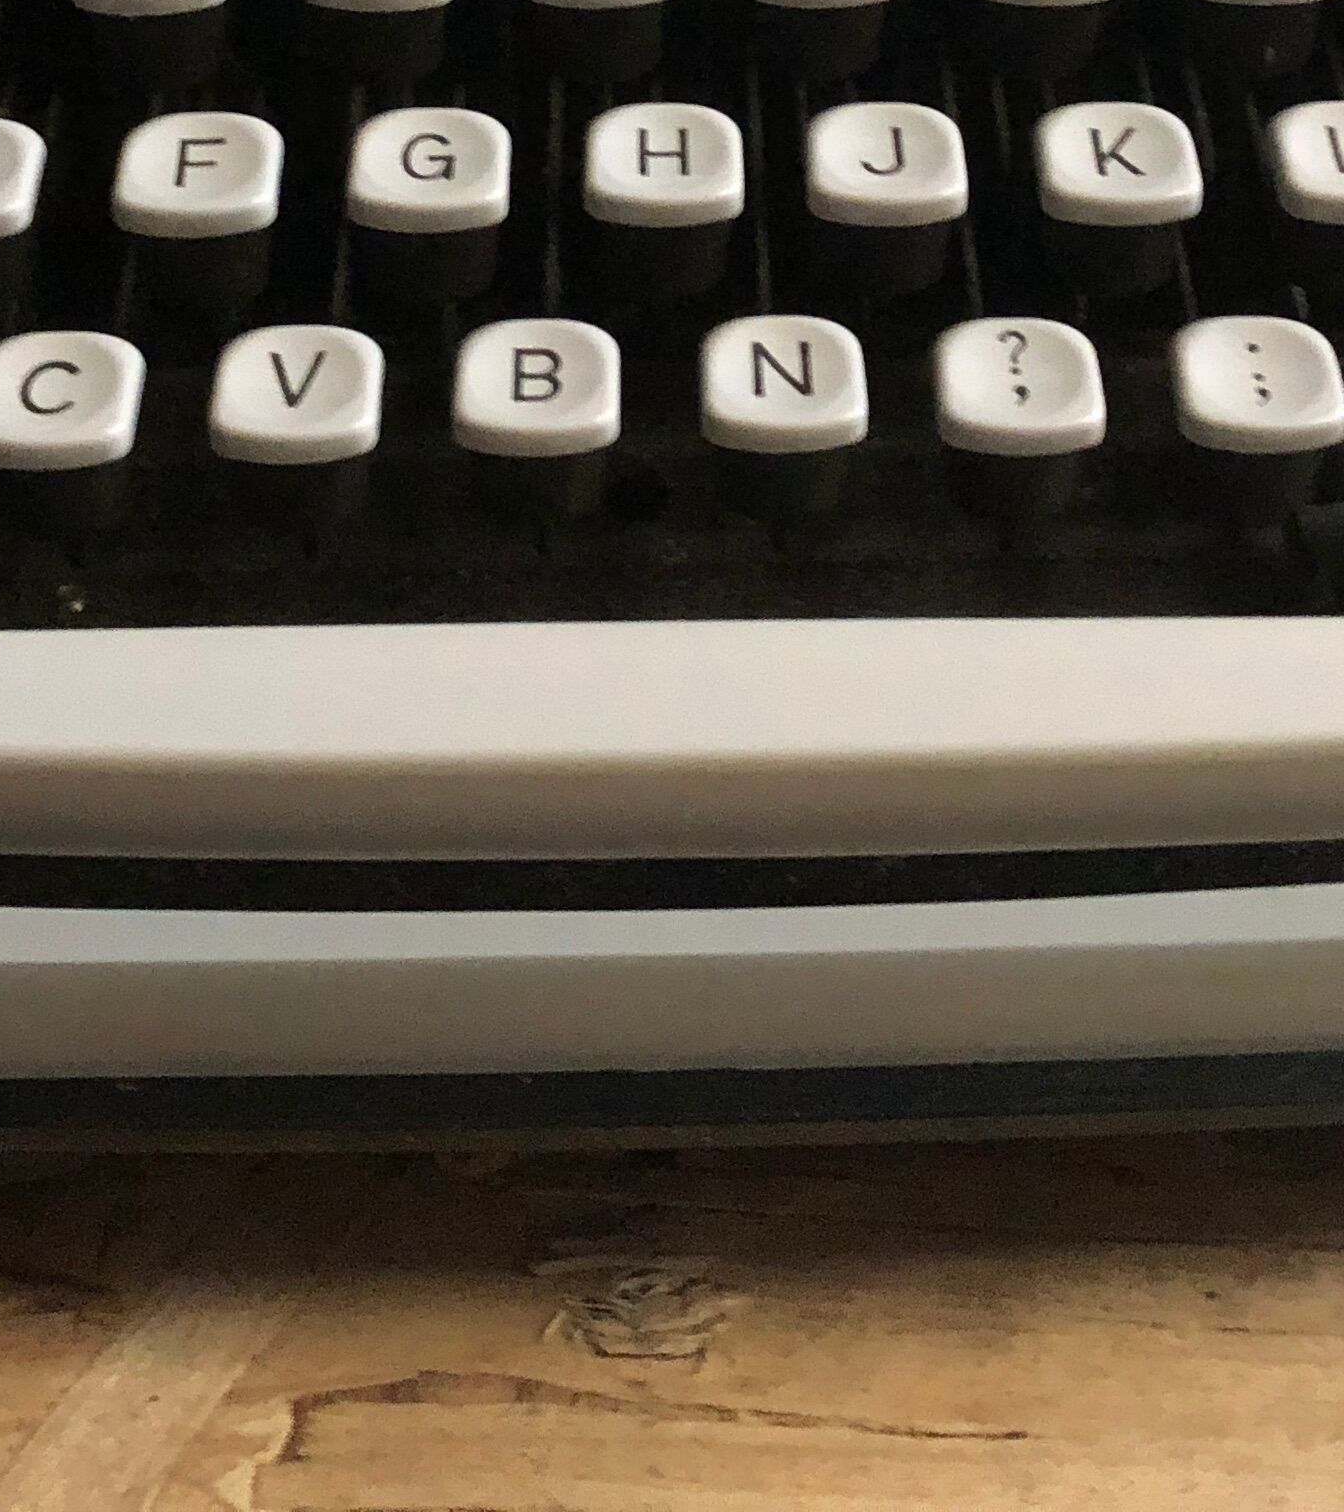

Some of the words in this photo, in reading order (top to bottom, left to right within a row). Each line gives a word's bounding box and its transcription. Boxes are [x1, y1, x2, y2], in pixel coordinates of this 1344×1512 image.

[174, 137, 227, 188] F
[400, 133, 456, 181] G
[638, 127, 690, 177] H
[860, 126, 905, 176] J
[1089, 127, 1146, 177] K
[511, 347, 563, 403] B
[751, 341, 814, 398] N
[997, 329, 1028, 375] ?
[19, 360, 81, 416] C
[269, 351, 325, 408] V
